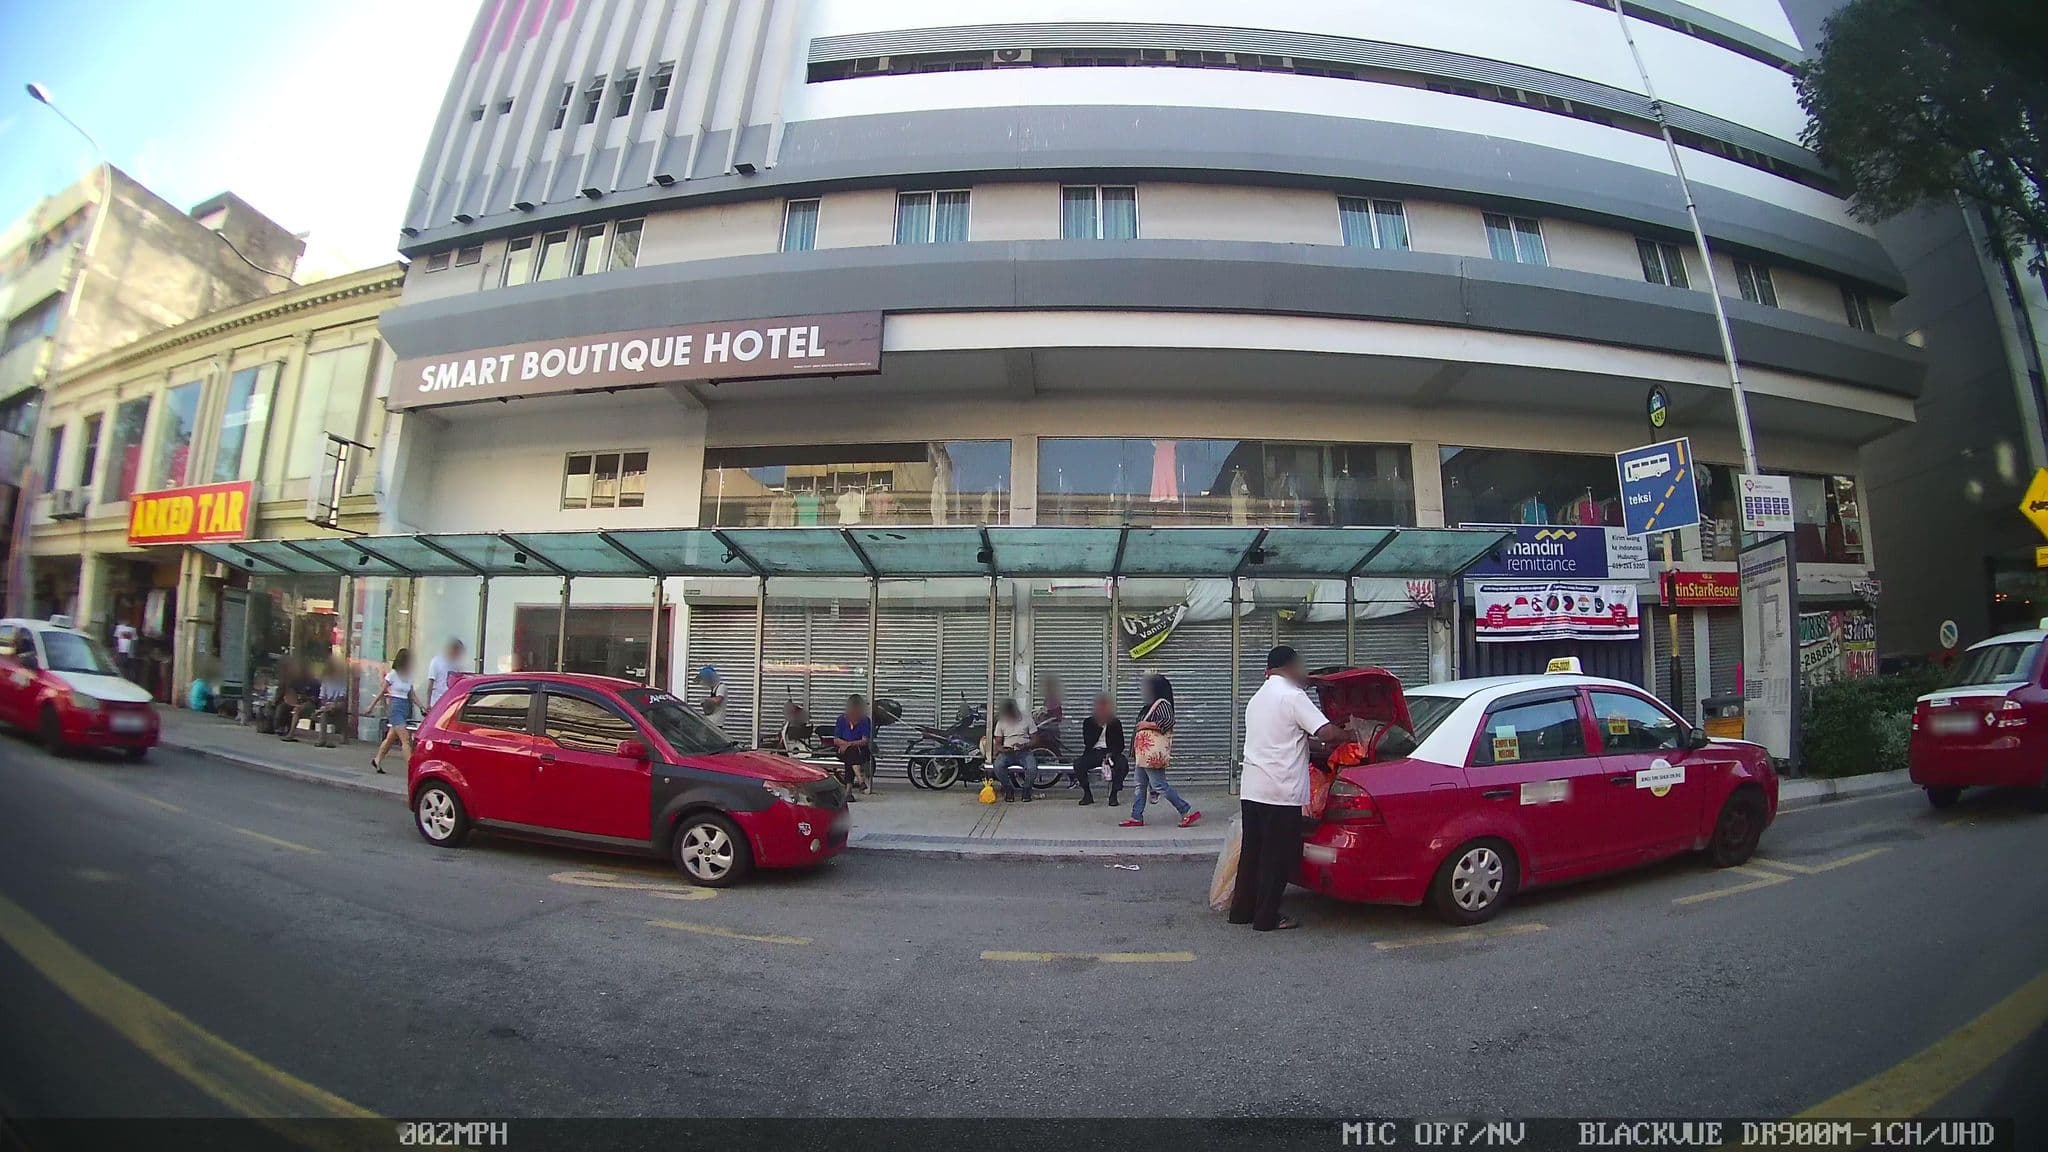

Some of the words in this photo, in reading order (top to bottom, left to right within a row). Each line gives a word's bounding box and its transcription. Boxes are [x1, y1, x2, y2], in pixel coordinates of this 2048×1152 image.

[419, 354, 515, 392] SMART
[520, 335, 692, 380] BOUTIQUE
[703, 326, 825, 363] HOTEL
[1628, 491, 1652, 505] teksi
[130, 496, 194, 537] ARKED
[197, 490, 244, 533] TAR
[1507, 557, 1577, 571] remittance
